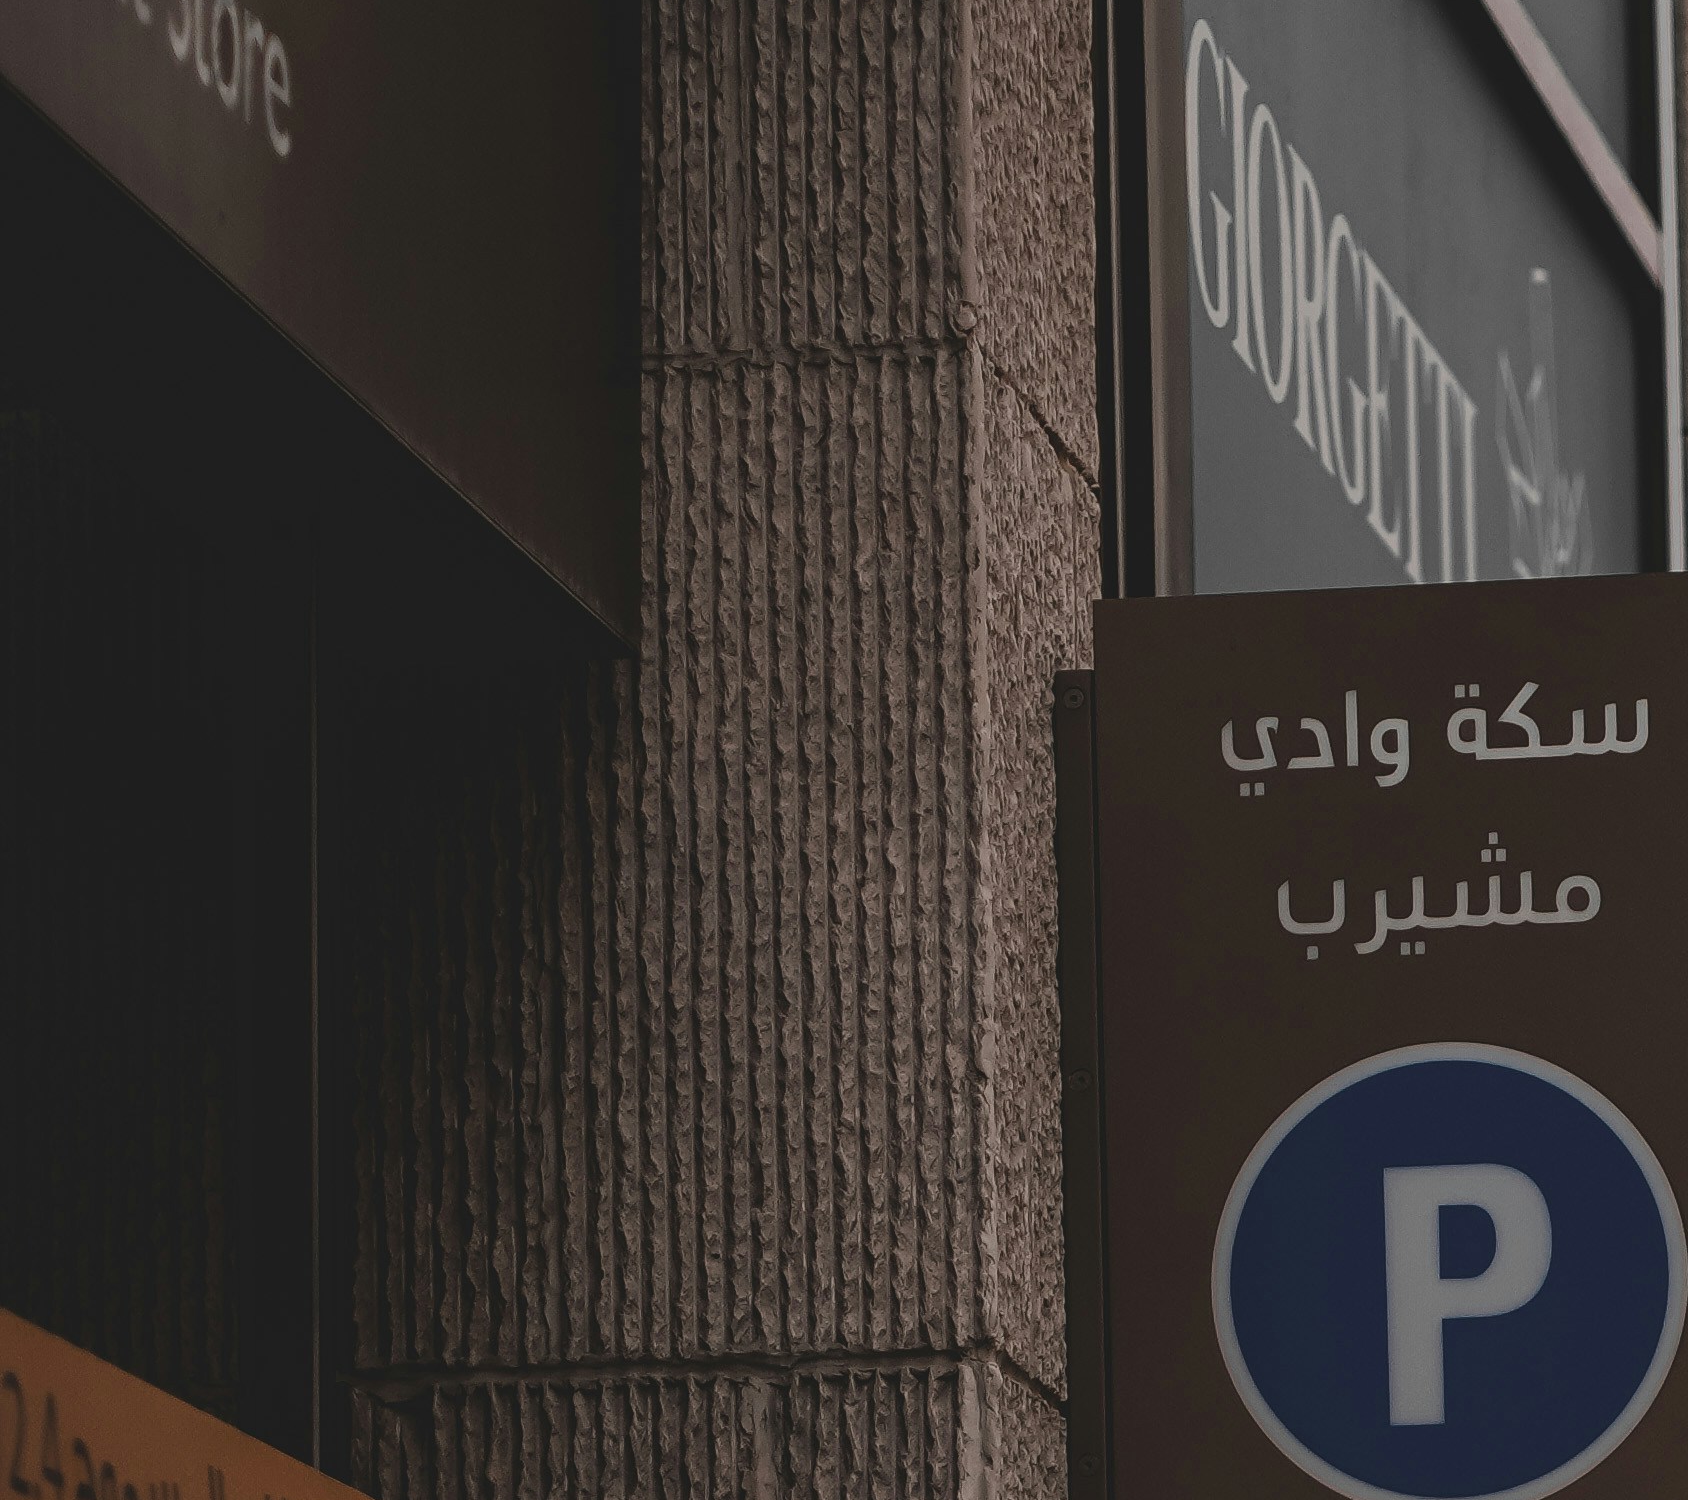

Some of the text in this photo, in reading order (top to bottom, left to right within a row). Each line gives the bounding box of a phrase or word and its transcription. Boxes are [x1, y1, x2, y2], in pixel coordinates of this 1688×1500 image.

[1219, 680, 1650, 797] سكة وادي
[1276, 831, 1602, 961] مشيرب
[1382, 1162, 1553, 1427] P
